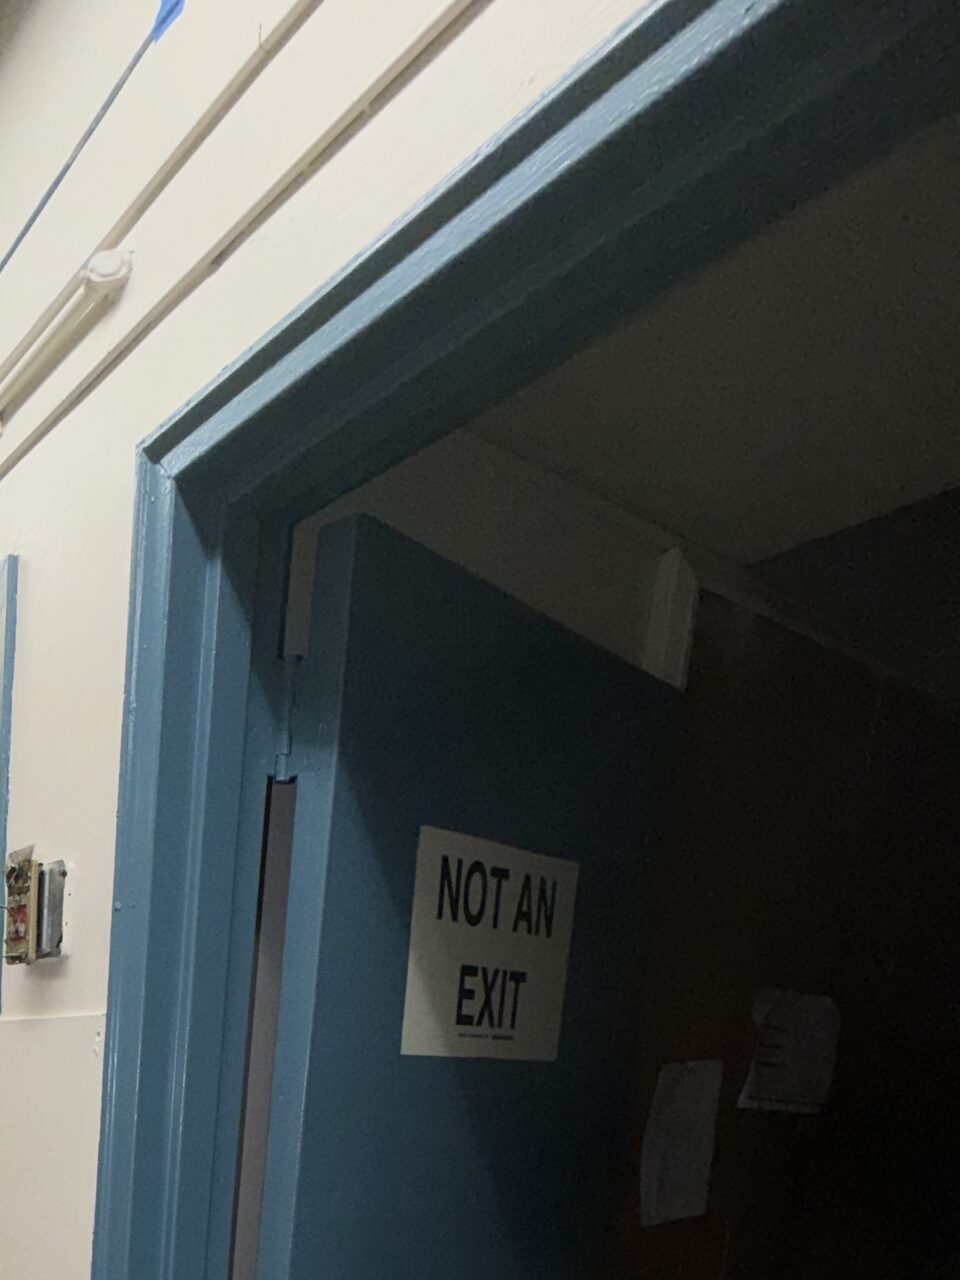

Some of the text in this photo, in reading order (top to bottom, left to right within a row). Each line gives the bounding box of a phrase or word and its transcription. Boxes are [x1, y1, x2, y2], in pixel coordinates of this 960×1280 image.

[437, 855, 557, 938] NOT AN
[456, 964, 527, 1030] EXIT
